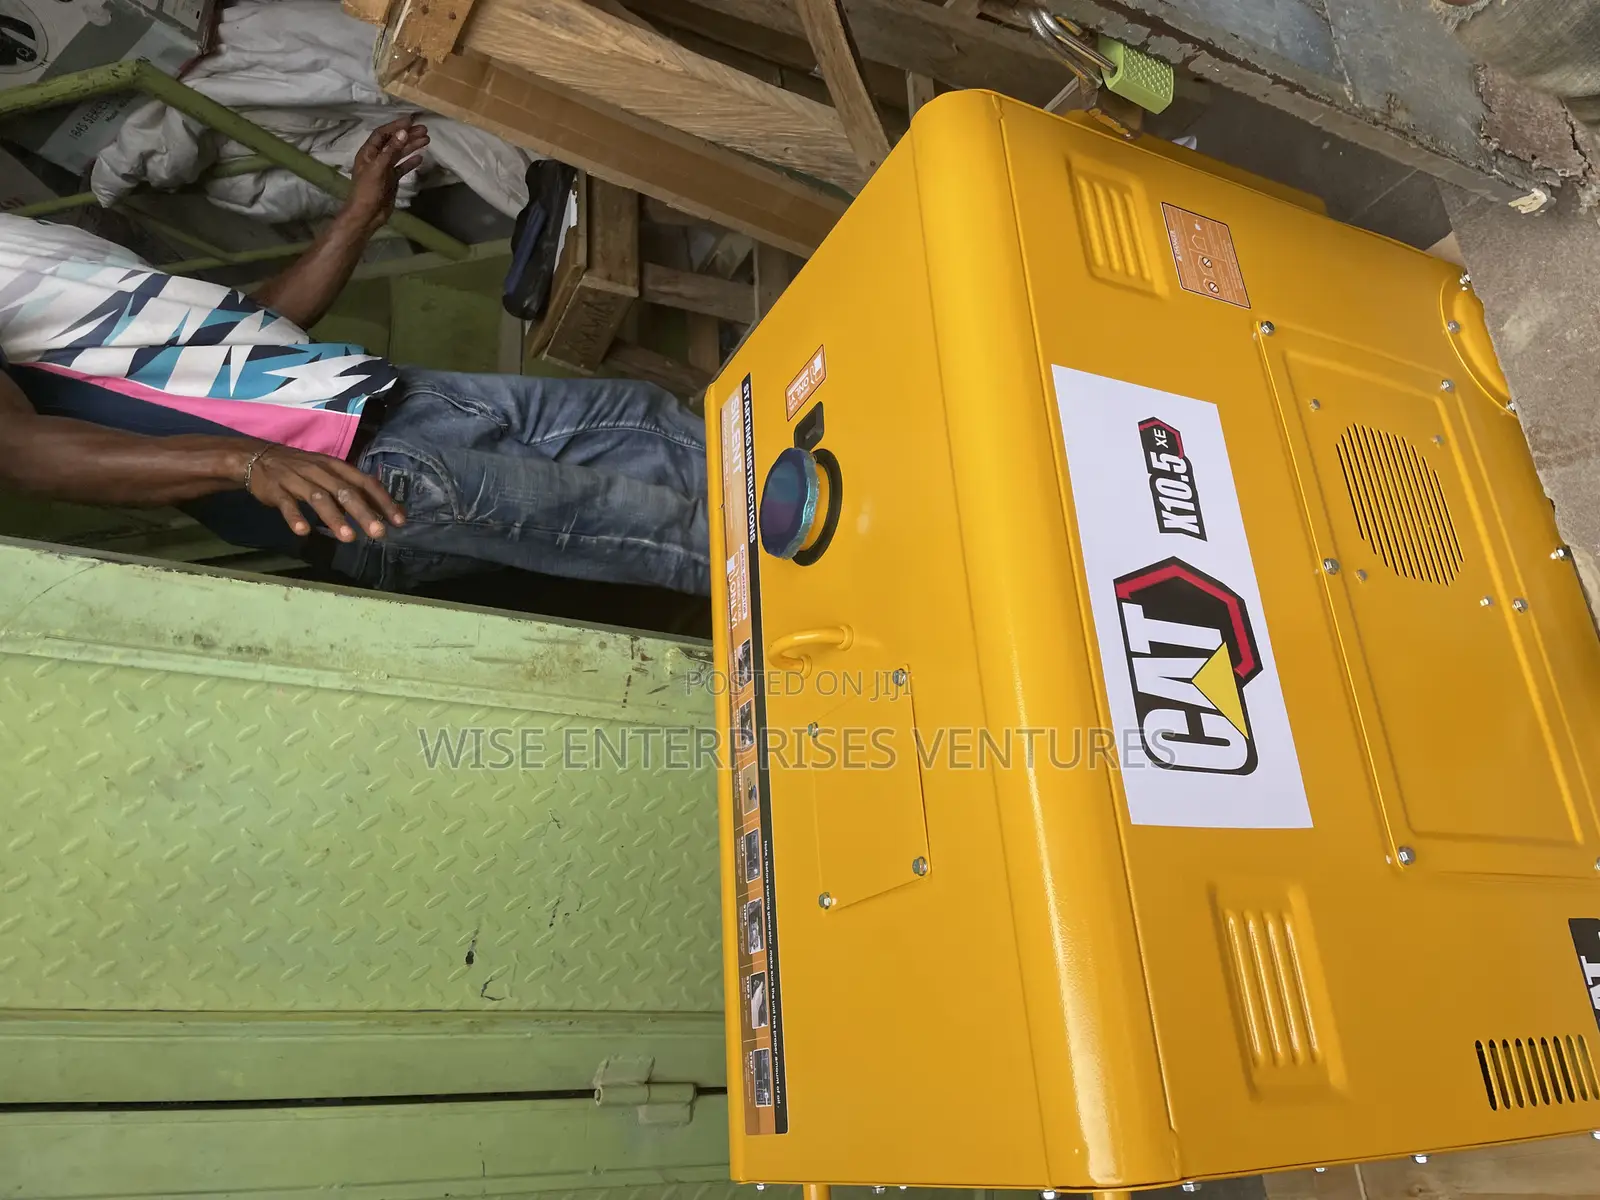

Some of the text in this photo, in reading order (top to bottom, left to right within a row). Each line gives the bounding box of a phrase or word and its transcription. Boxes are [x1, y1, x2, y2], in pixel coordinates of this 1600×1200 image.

[731, 395, 742, 474] SILENT
[743, 383, 756, 543] STARTING INSTRUCTIONS
[1150, 428, 1200, 535] X10.5 XE
[1121, 602, 1249, 771] CAT
